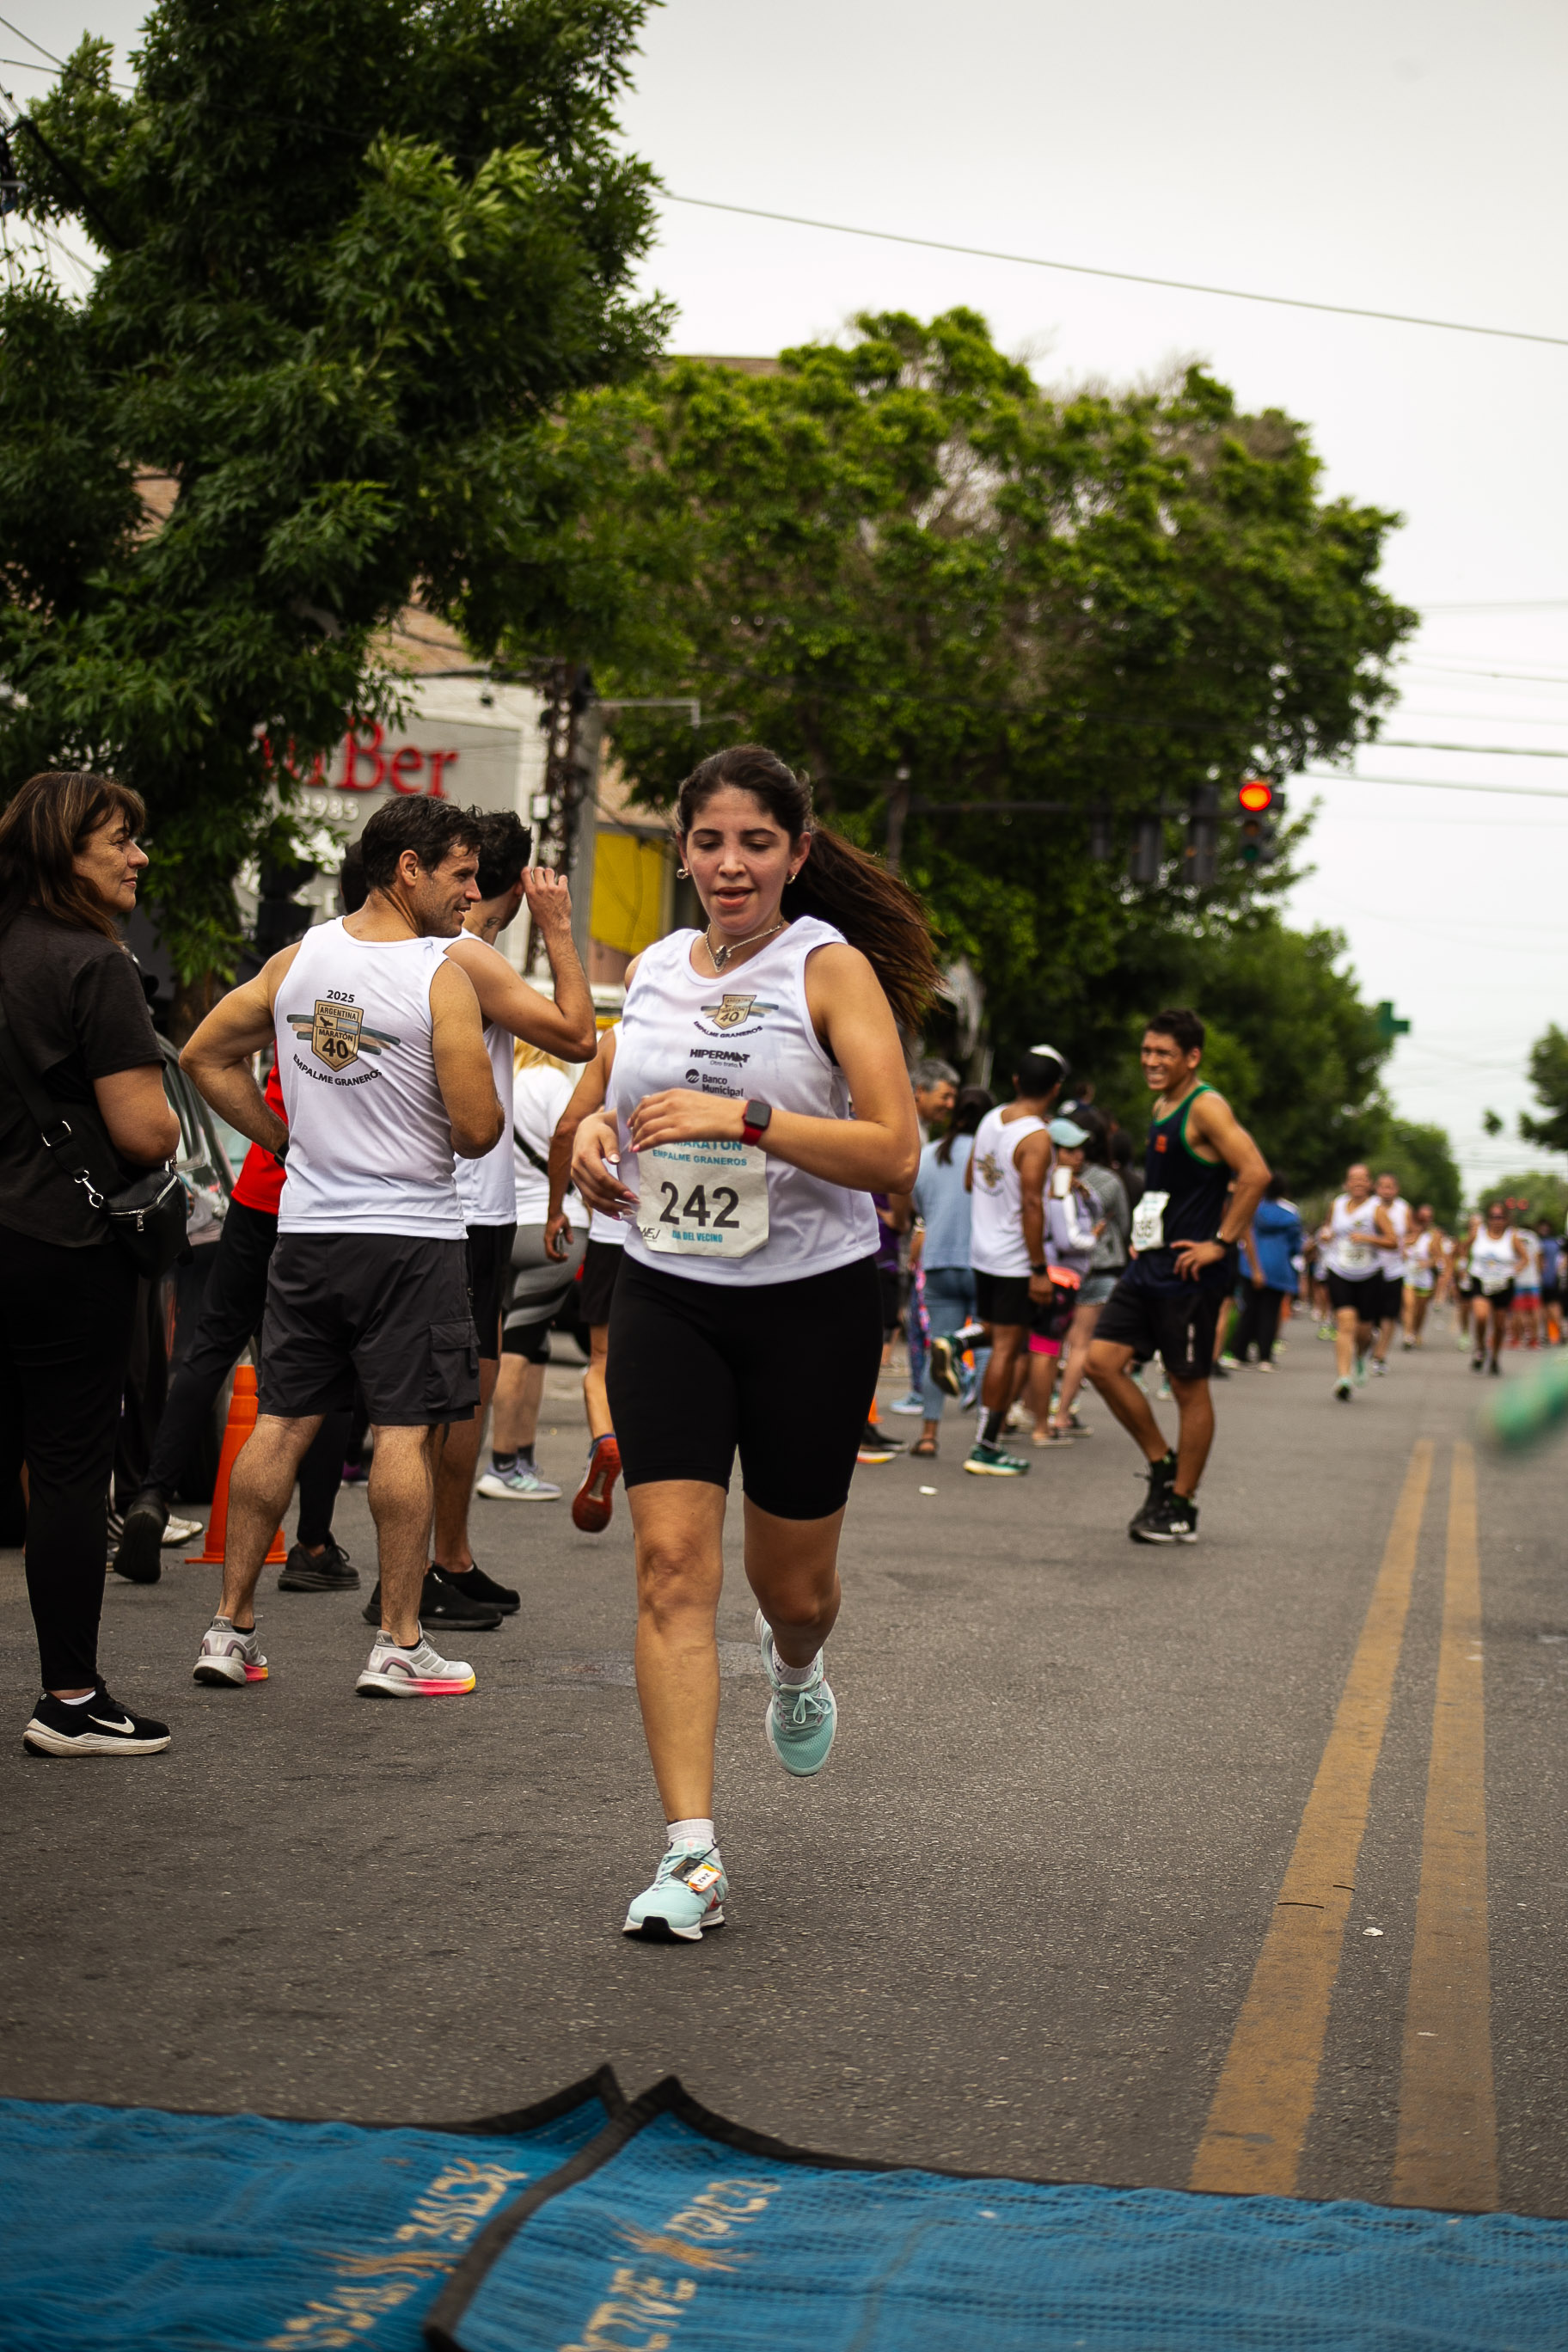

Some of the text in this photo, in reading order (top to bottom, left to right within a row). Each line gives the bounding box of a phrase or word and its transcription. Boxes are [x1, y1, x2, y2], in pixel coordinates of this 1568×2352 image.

[327, 989, 355, 1003] 2025
[320, 1007, 357, 1020] ARGENTINA
[720, 1011, 740, 1022] 40
[318, 1028, 353, 1042] MARATÓN
[693, 1020, 763, 1038] EMPALME GRANEROS
[322, 1038, 349, 1059] 40
[292, 1053, 383, 1087] EMPALME GRANEROS
[701, 1073, 728, 1085] Banco
[701, 1083, 744, 1098] Municipal
[652, 1149, 747, 1166] EMPALME GRANEROS
[660, 1181, 739, 1228] 242
[683, 1232, 695, 1240] DEL
[697, 1233, 723, 1242] VECINO
